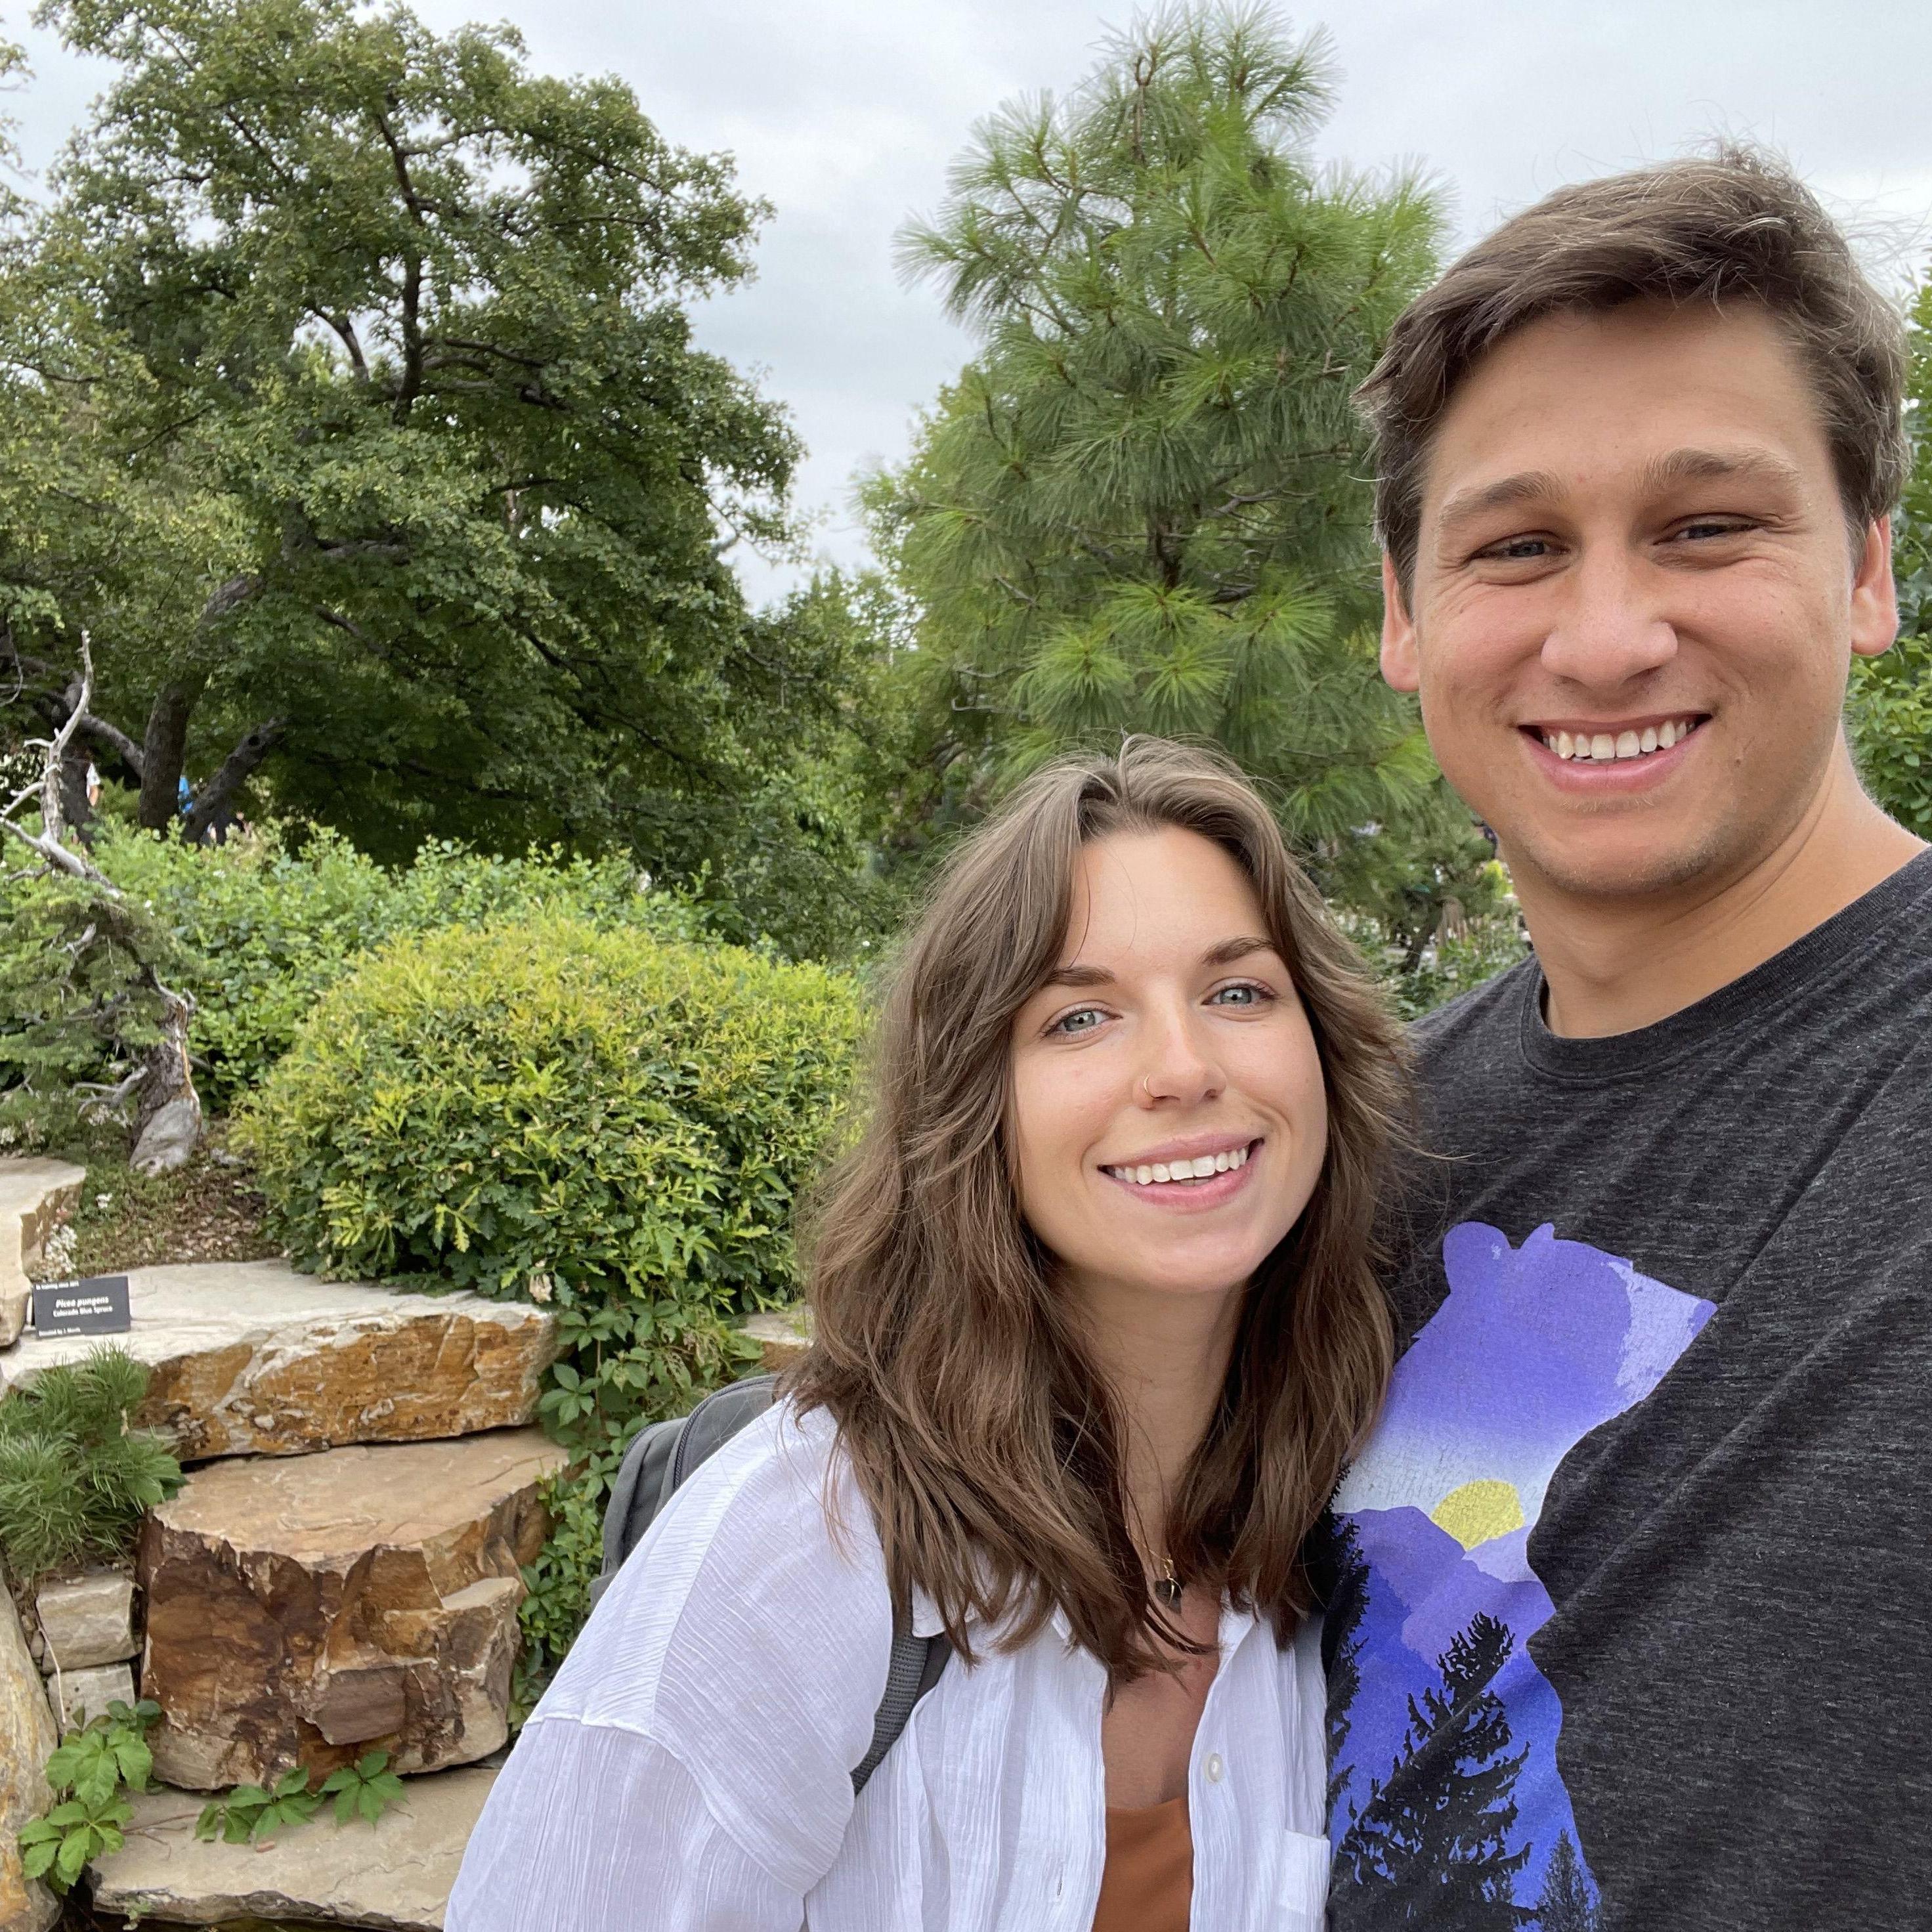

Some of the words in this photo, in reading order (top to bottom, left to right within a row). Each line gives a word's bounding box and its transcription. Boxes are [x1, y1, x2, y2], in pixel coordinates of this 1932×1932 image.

[56, 1299, 75, 1308] Picea
[77, 1297, 109, 1306] pungens
[53, 1308, 79, 1318] Colorado
[93, 1306, 113, 1314] Spruce
